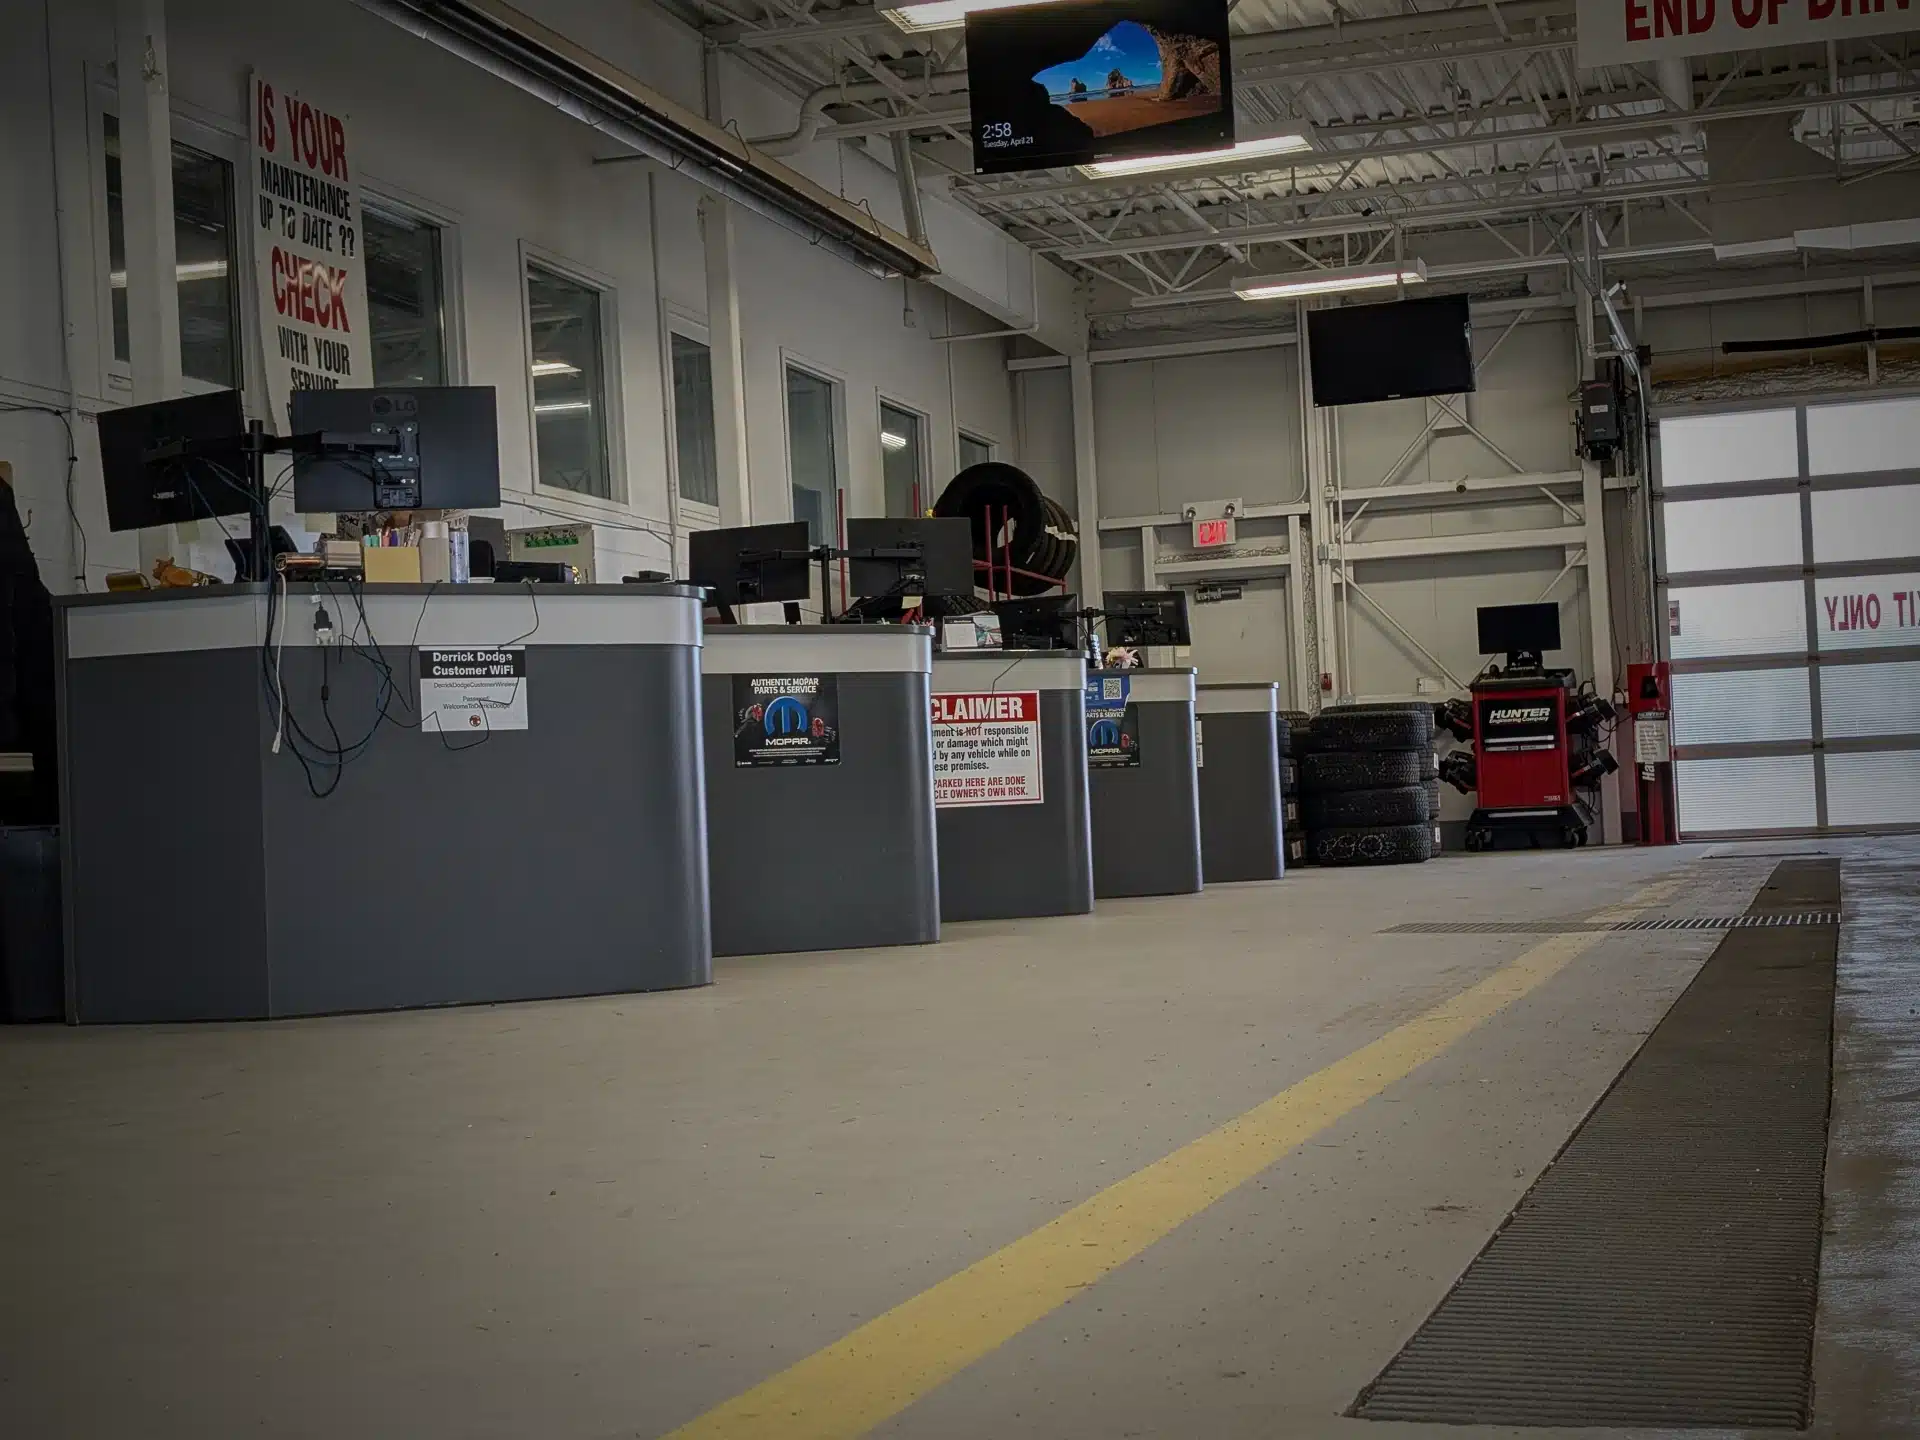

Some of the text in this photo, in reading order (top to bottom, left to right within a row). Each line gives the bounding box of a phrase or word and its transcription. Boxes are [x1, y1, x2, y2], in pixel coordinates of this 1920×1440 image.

[258, 80, 348, 182] IS YOUR
[982, 122, 1012, 139] 2:58
[983, 136, 1034, 148] Tuesday, April 21
[260, 157, 352, 221] MAINTENANCE
[259, 194, 355, 256] UP TO DATE ??
[271, 246, 350, 333] CHECK
[278, 325, 351, 375] WITH YOUR
[1199, 520, 1227, 545] EXIT
[432, 651, 512, 663] Derrick Dodge
[432, 665, 514, 676] Customer WiFi
[751, 677, 819, 687] AUTHENTIC MOPAR
[1489, 708, 1550, 719] HUNTER
[957, 727, 964, 735] is
[966, 727, 982, 735] NOT
[984, 726, 1029, 737] responsible
[765, 738, 809, 746] MOPAR
[947, 738, 978, 749] damage
[981, 737, 1004, 745] which
[1006, 736, 1028, 747] might
[939, 751, 948, 761] by
[951, 752, 965, 761] any
[968, 749, 995, 758] vehicle
[998, 747, 1018, 757] while
[1021, 749, 1030, 757] on
[951, 761, 989, 772] premises.
[965, 778, 985, 786] HERE
[988, 777, 1003, 785] ARE
[1005, 776, 1025, 785] DONE
[950, 788, 986, 798] OWNER'S
[988, 787, 1006, 796] OWN
[1008, 786, 1028, 796] RISK.
